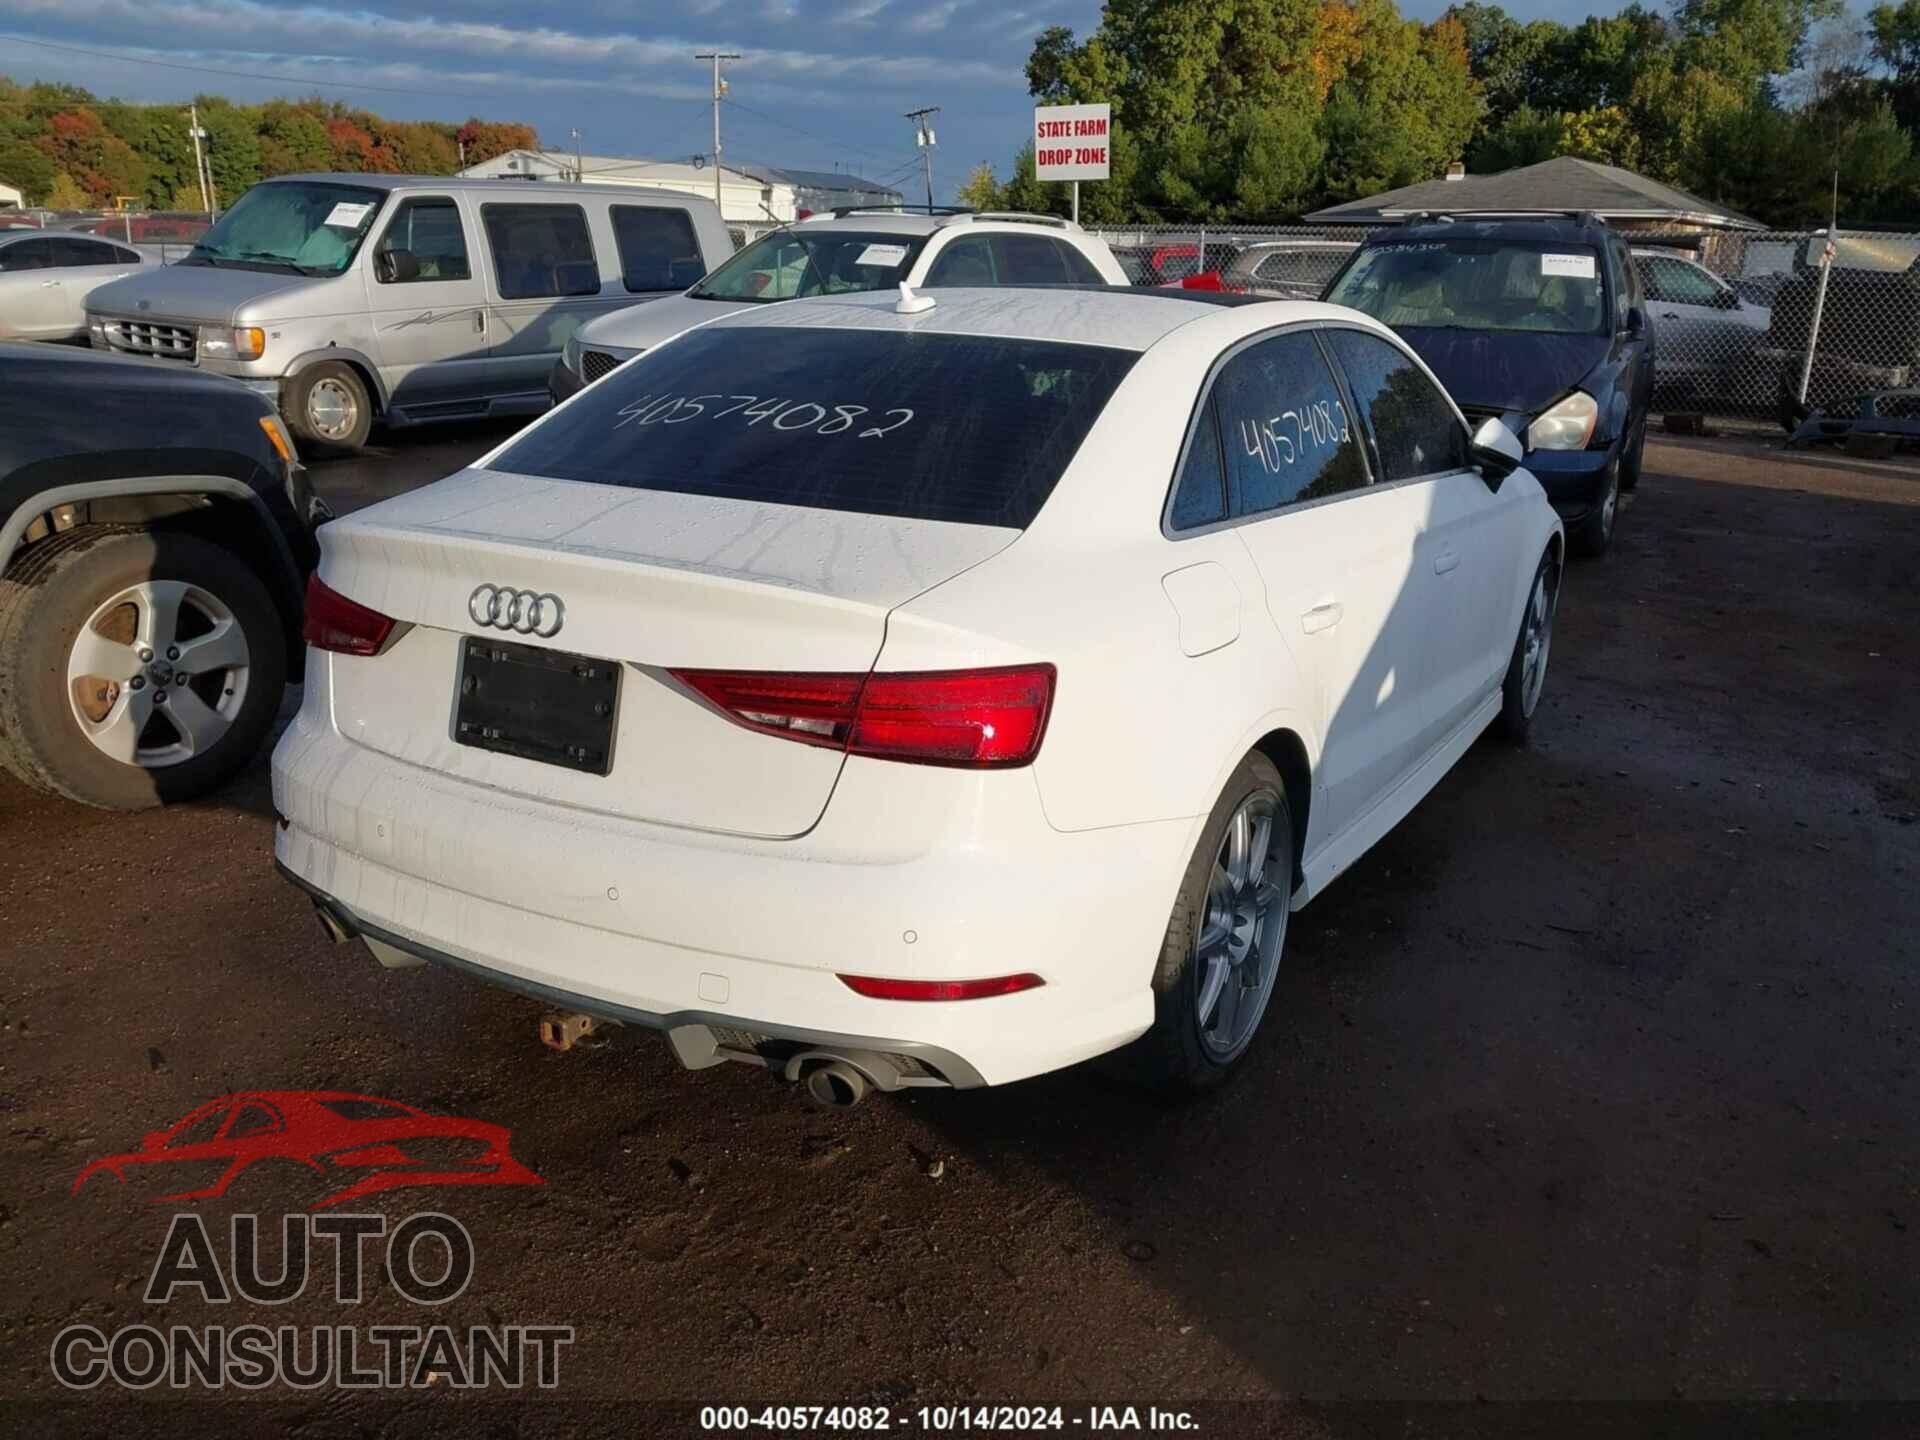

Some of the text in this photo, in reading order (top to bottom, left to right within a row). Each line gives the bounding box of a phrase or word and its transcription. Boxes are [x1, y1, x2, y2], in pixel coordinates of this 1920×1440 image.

[1038, 119, 1107, 138] STATE FARM
[1038, 147, 1106, 166] DROP ZONE
[612, 393, 915, 438] 40574082
[1240, 400, 1352, 473] 40574082
